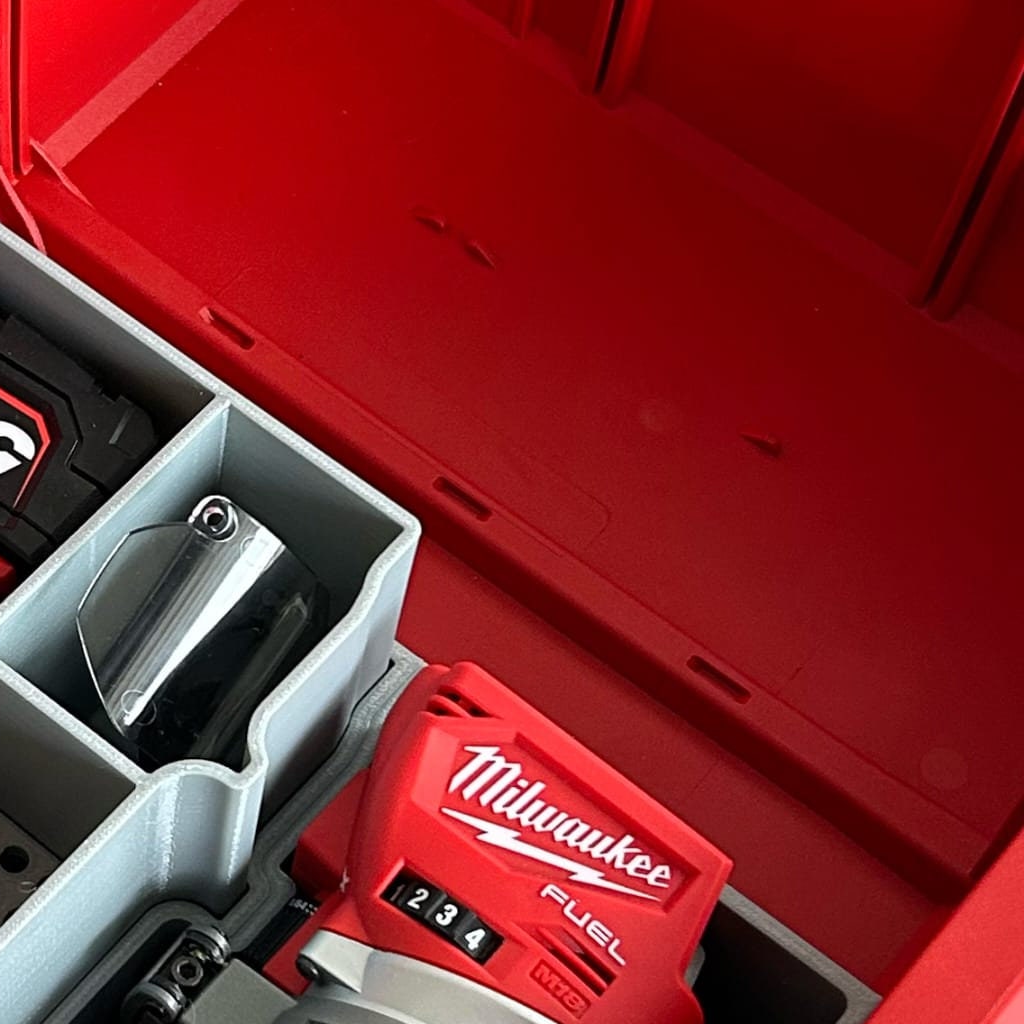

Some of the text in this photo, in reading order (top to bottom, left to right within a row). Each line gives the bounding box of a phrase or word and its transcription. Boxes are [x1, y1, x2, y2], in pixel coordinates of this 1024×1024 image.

[448, 744, 672, 889] Milwaukee
[540, 883, 627, 966] FUEL
[532, 964, 587, 1015] M18
